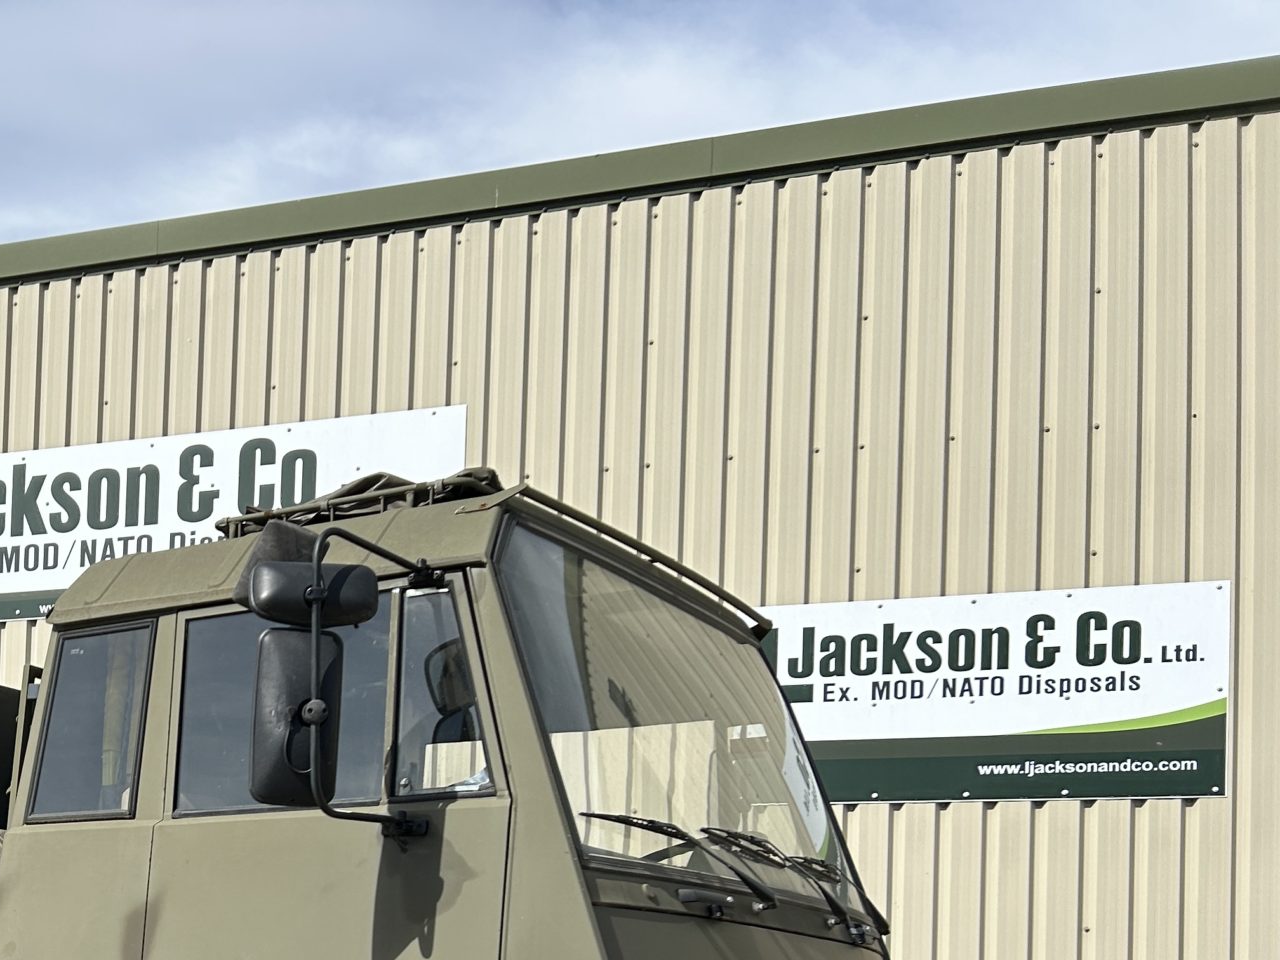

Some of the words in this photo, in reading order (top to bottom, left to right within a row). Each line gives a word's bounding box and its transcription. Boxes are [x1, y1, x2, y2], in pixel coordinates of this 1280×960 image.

[177, 444, 220, 523] &
[1024, 613, 1061, 670] &
[1075, 610, 1154, 668] Co.
[1161, 643, 1206, 664] Ltd.
[822, 682, 859, 703] Ex.
[871, 675, 1006, 701] MOD/NATO
[1018, 670, 1142, 698] Disposals
[977, 757, 1198, 779] www.ljacksonandco.com
